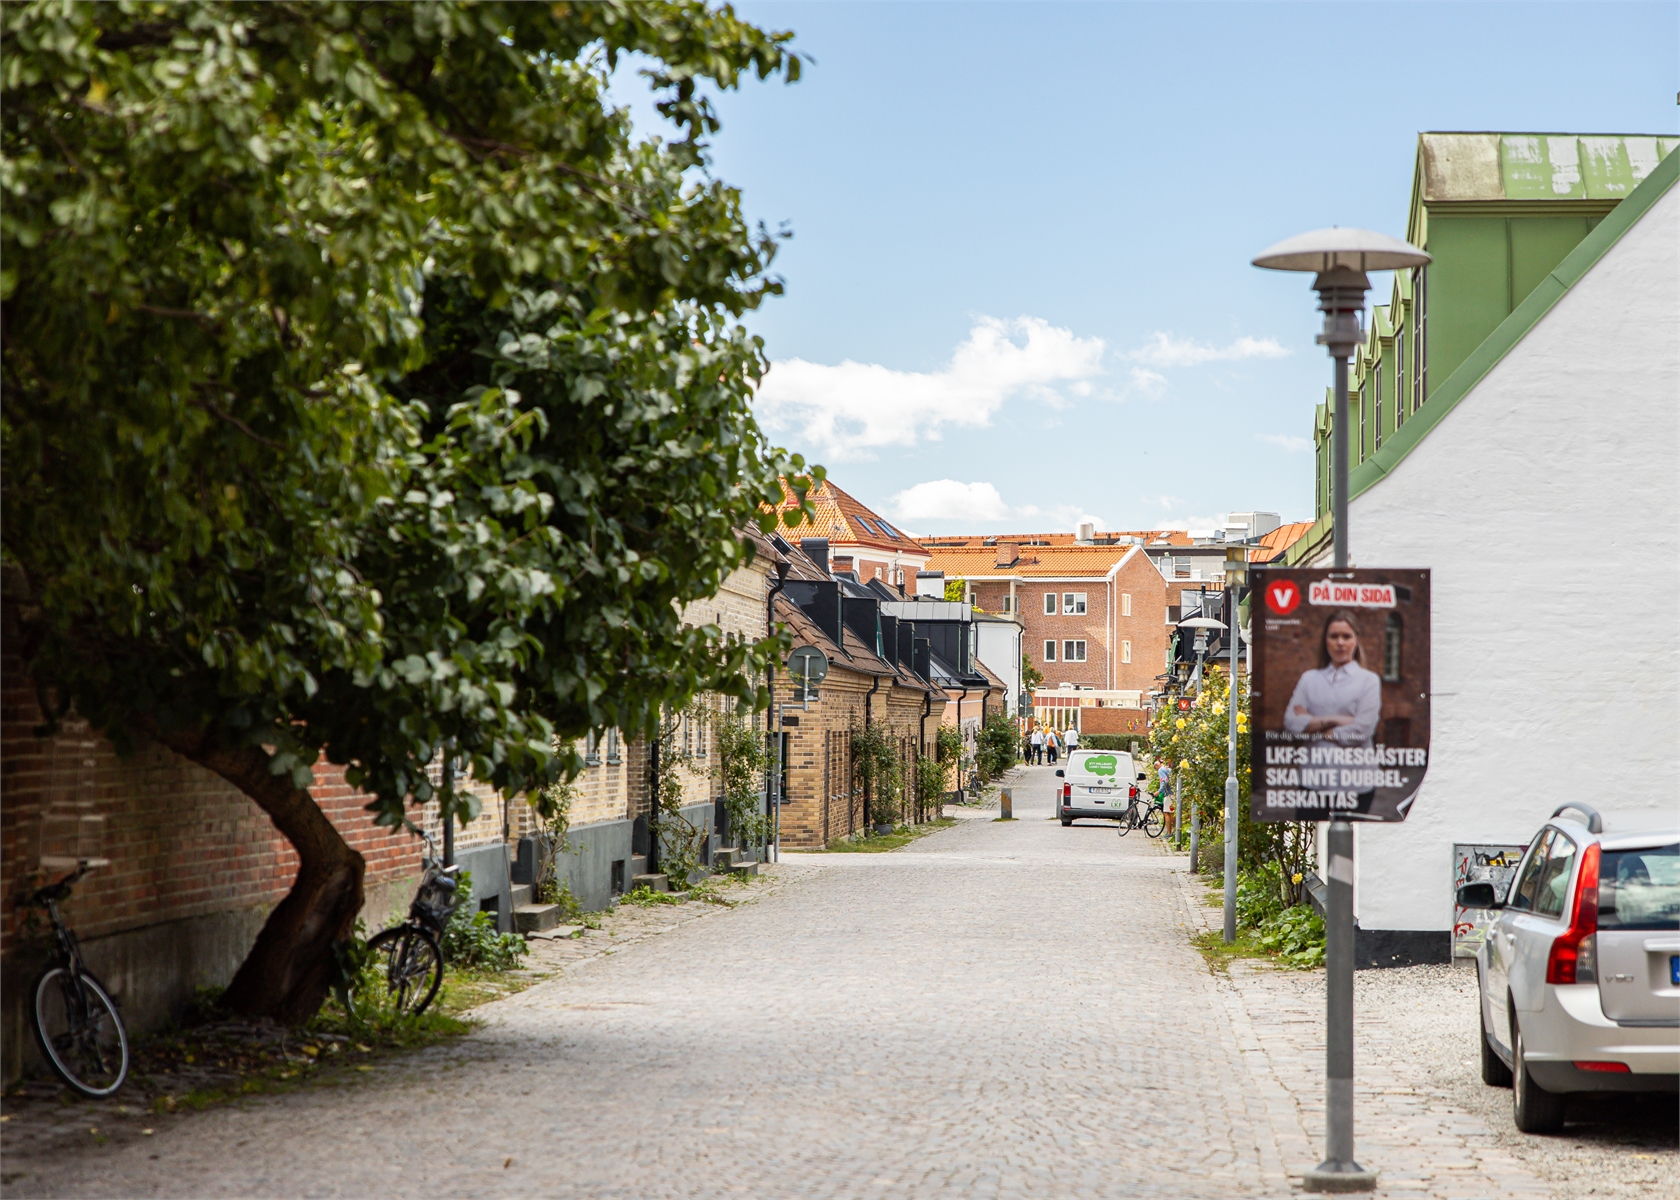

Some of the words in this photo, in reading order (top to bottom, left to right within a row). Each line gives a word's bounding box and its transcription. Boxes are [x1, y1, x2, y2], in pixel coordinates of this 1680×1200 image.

[1273, 588, 1293, 608] V
[1313, 583, 1330, 601] PÅ
[1334, 588, 1357, 602] DIN
[1361, 588, 1391, 604] SIDA
[1279, 730, 1293, 742] dig
[1295, 732, 1310, 740] som
[1266, 746, 1308, 764] LKF:S
[1311, 744, 1426, 766] HYRESGÄSTER
[1266, 768, 1299, 786] SKA
[1302, 769, 1337, 786] INTE
[1341, 769, 1409, 787] DUBBEL-
[1266, 789, 1358, 808] BESKATTAS
